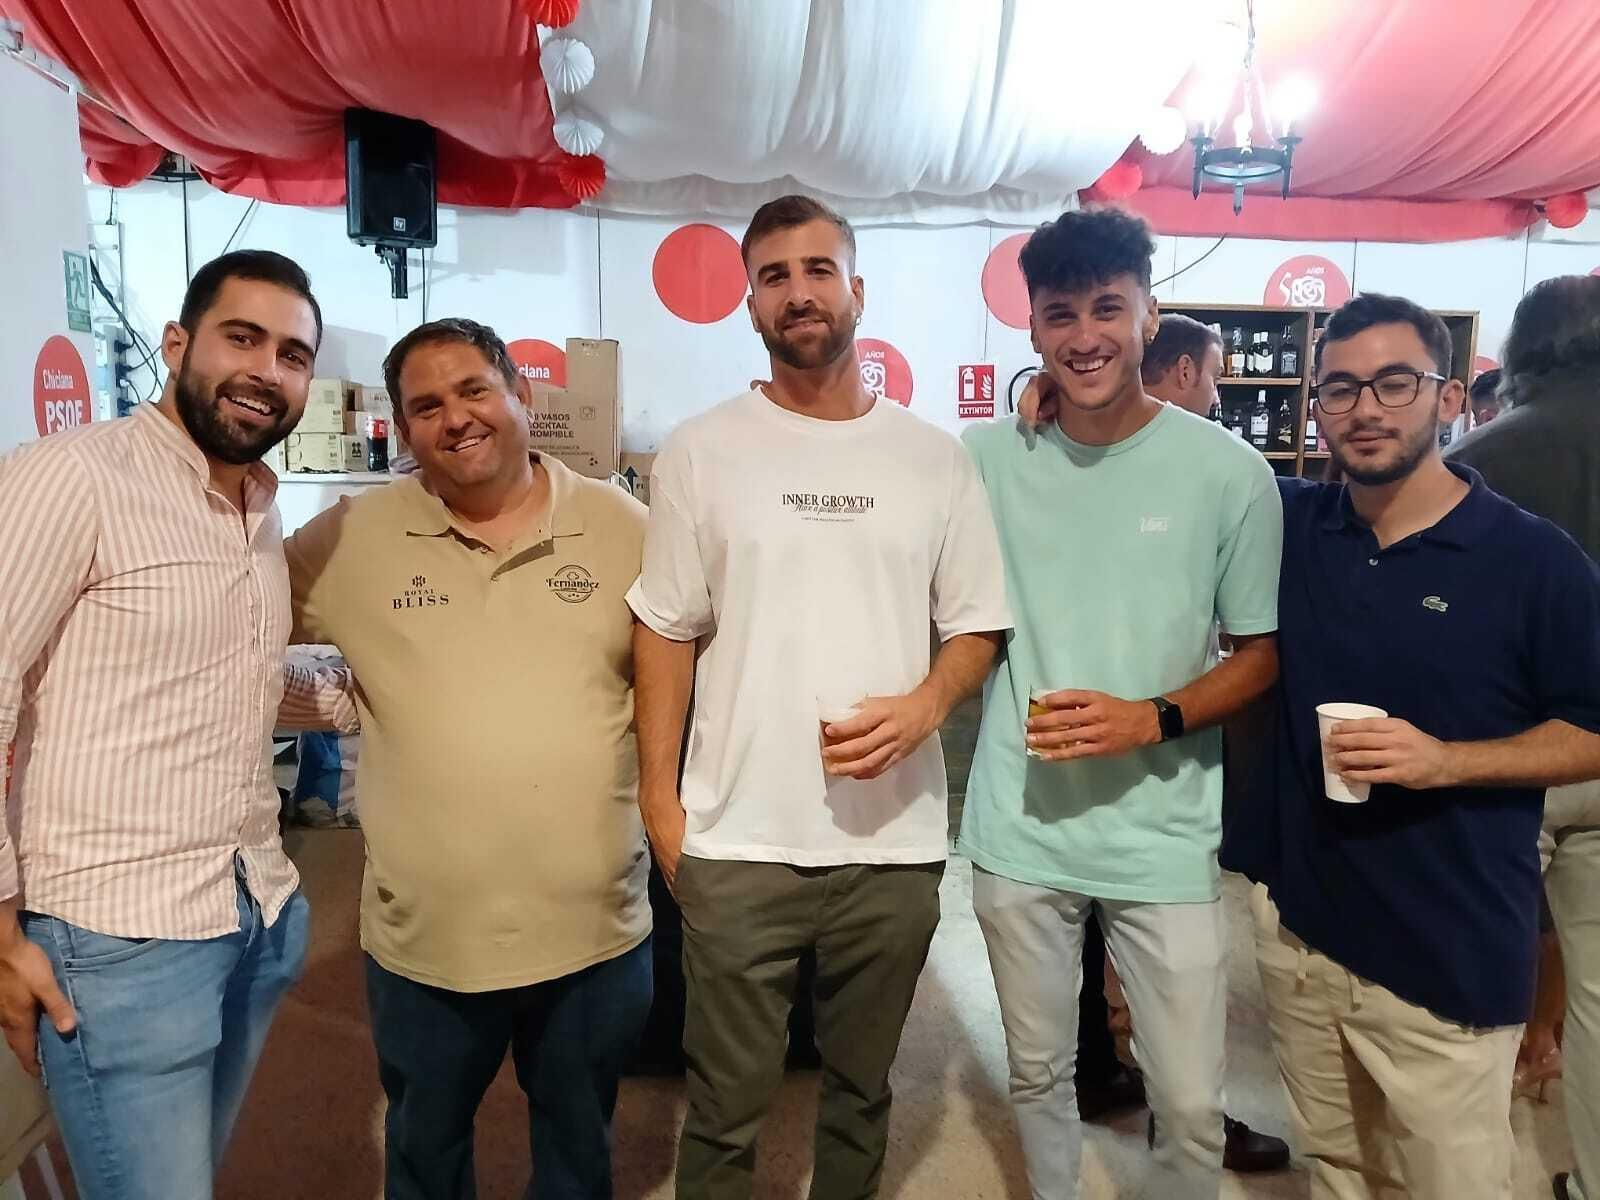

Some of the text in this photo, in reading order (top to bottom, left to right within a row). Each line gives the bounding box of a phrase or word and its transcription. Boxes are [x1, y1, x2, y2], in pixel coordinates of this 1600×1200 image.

[518, 363, 550, 378] clana
[42, 368, 74, 390] Chiclana
[541, 413, 570, 421] VASOS
[960, 406, 993, 415] EXTINTOR
[782, 494, 874, 508] INNER GROWTH
[393, 595, 449, 609] BLISS
